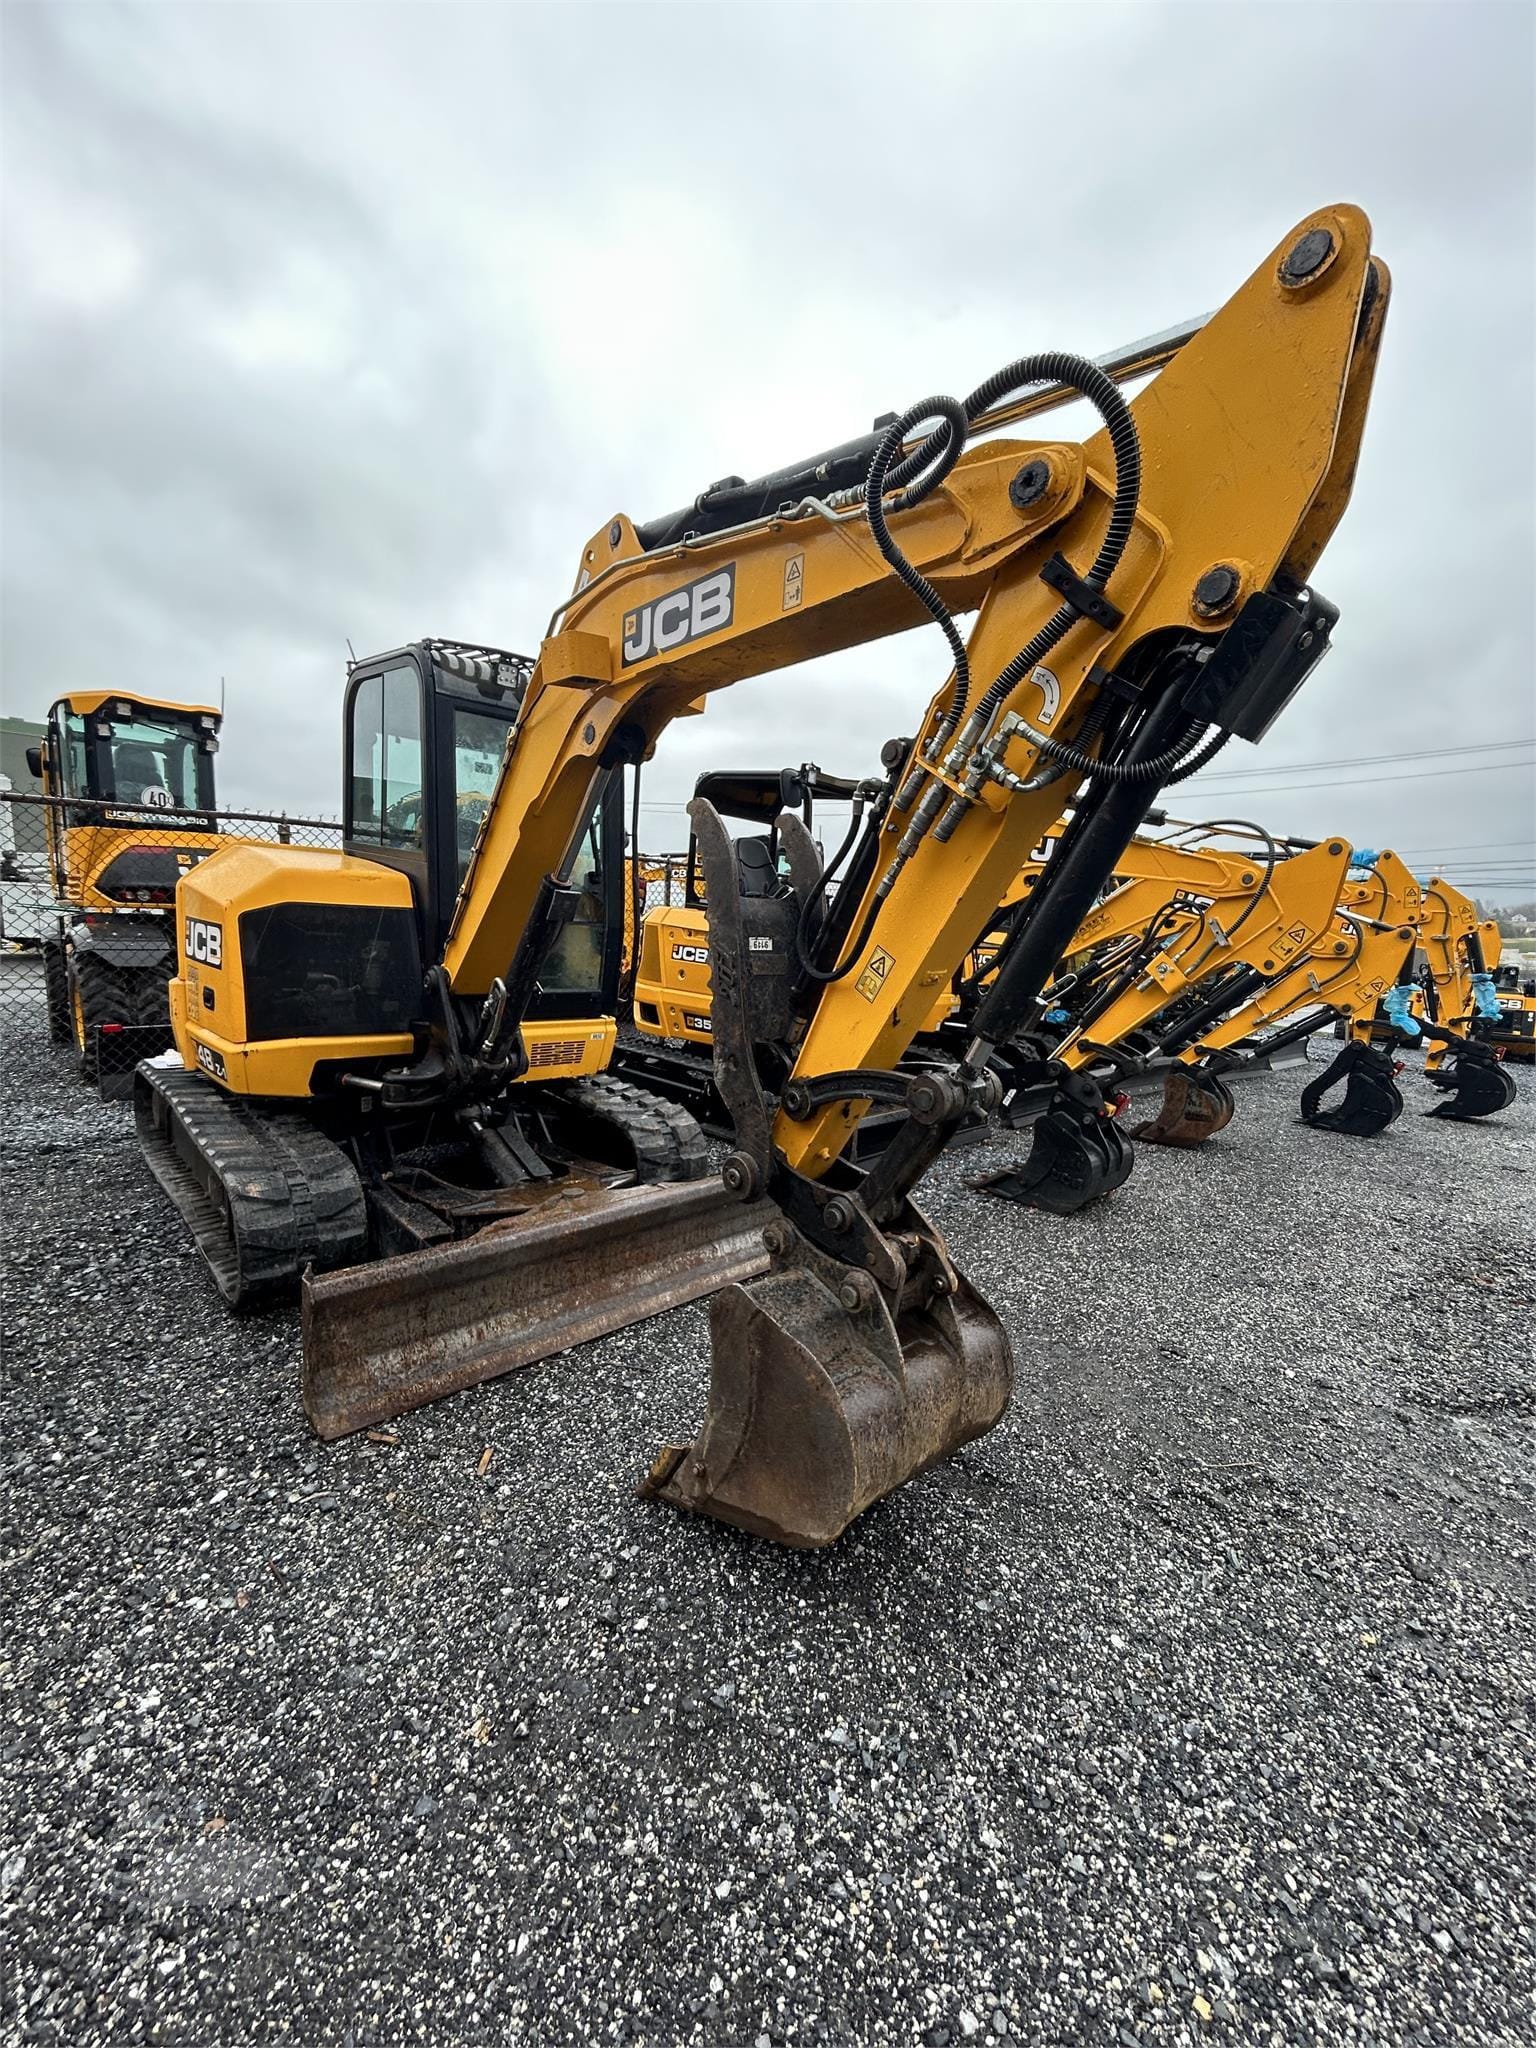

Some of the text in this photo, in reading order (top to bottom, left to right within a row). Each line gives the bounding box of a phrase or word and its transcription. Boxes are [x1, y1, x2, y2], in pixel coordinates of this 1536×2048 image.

[624, 572, 732, 662] JCB
[186, 920, 222, 966] JCB
[672, 948, 709, 963] JCB
[1496, 999, 1522, 1009] CB
